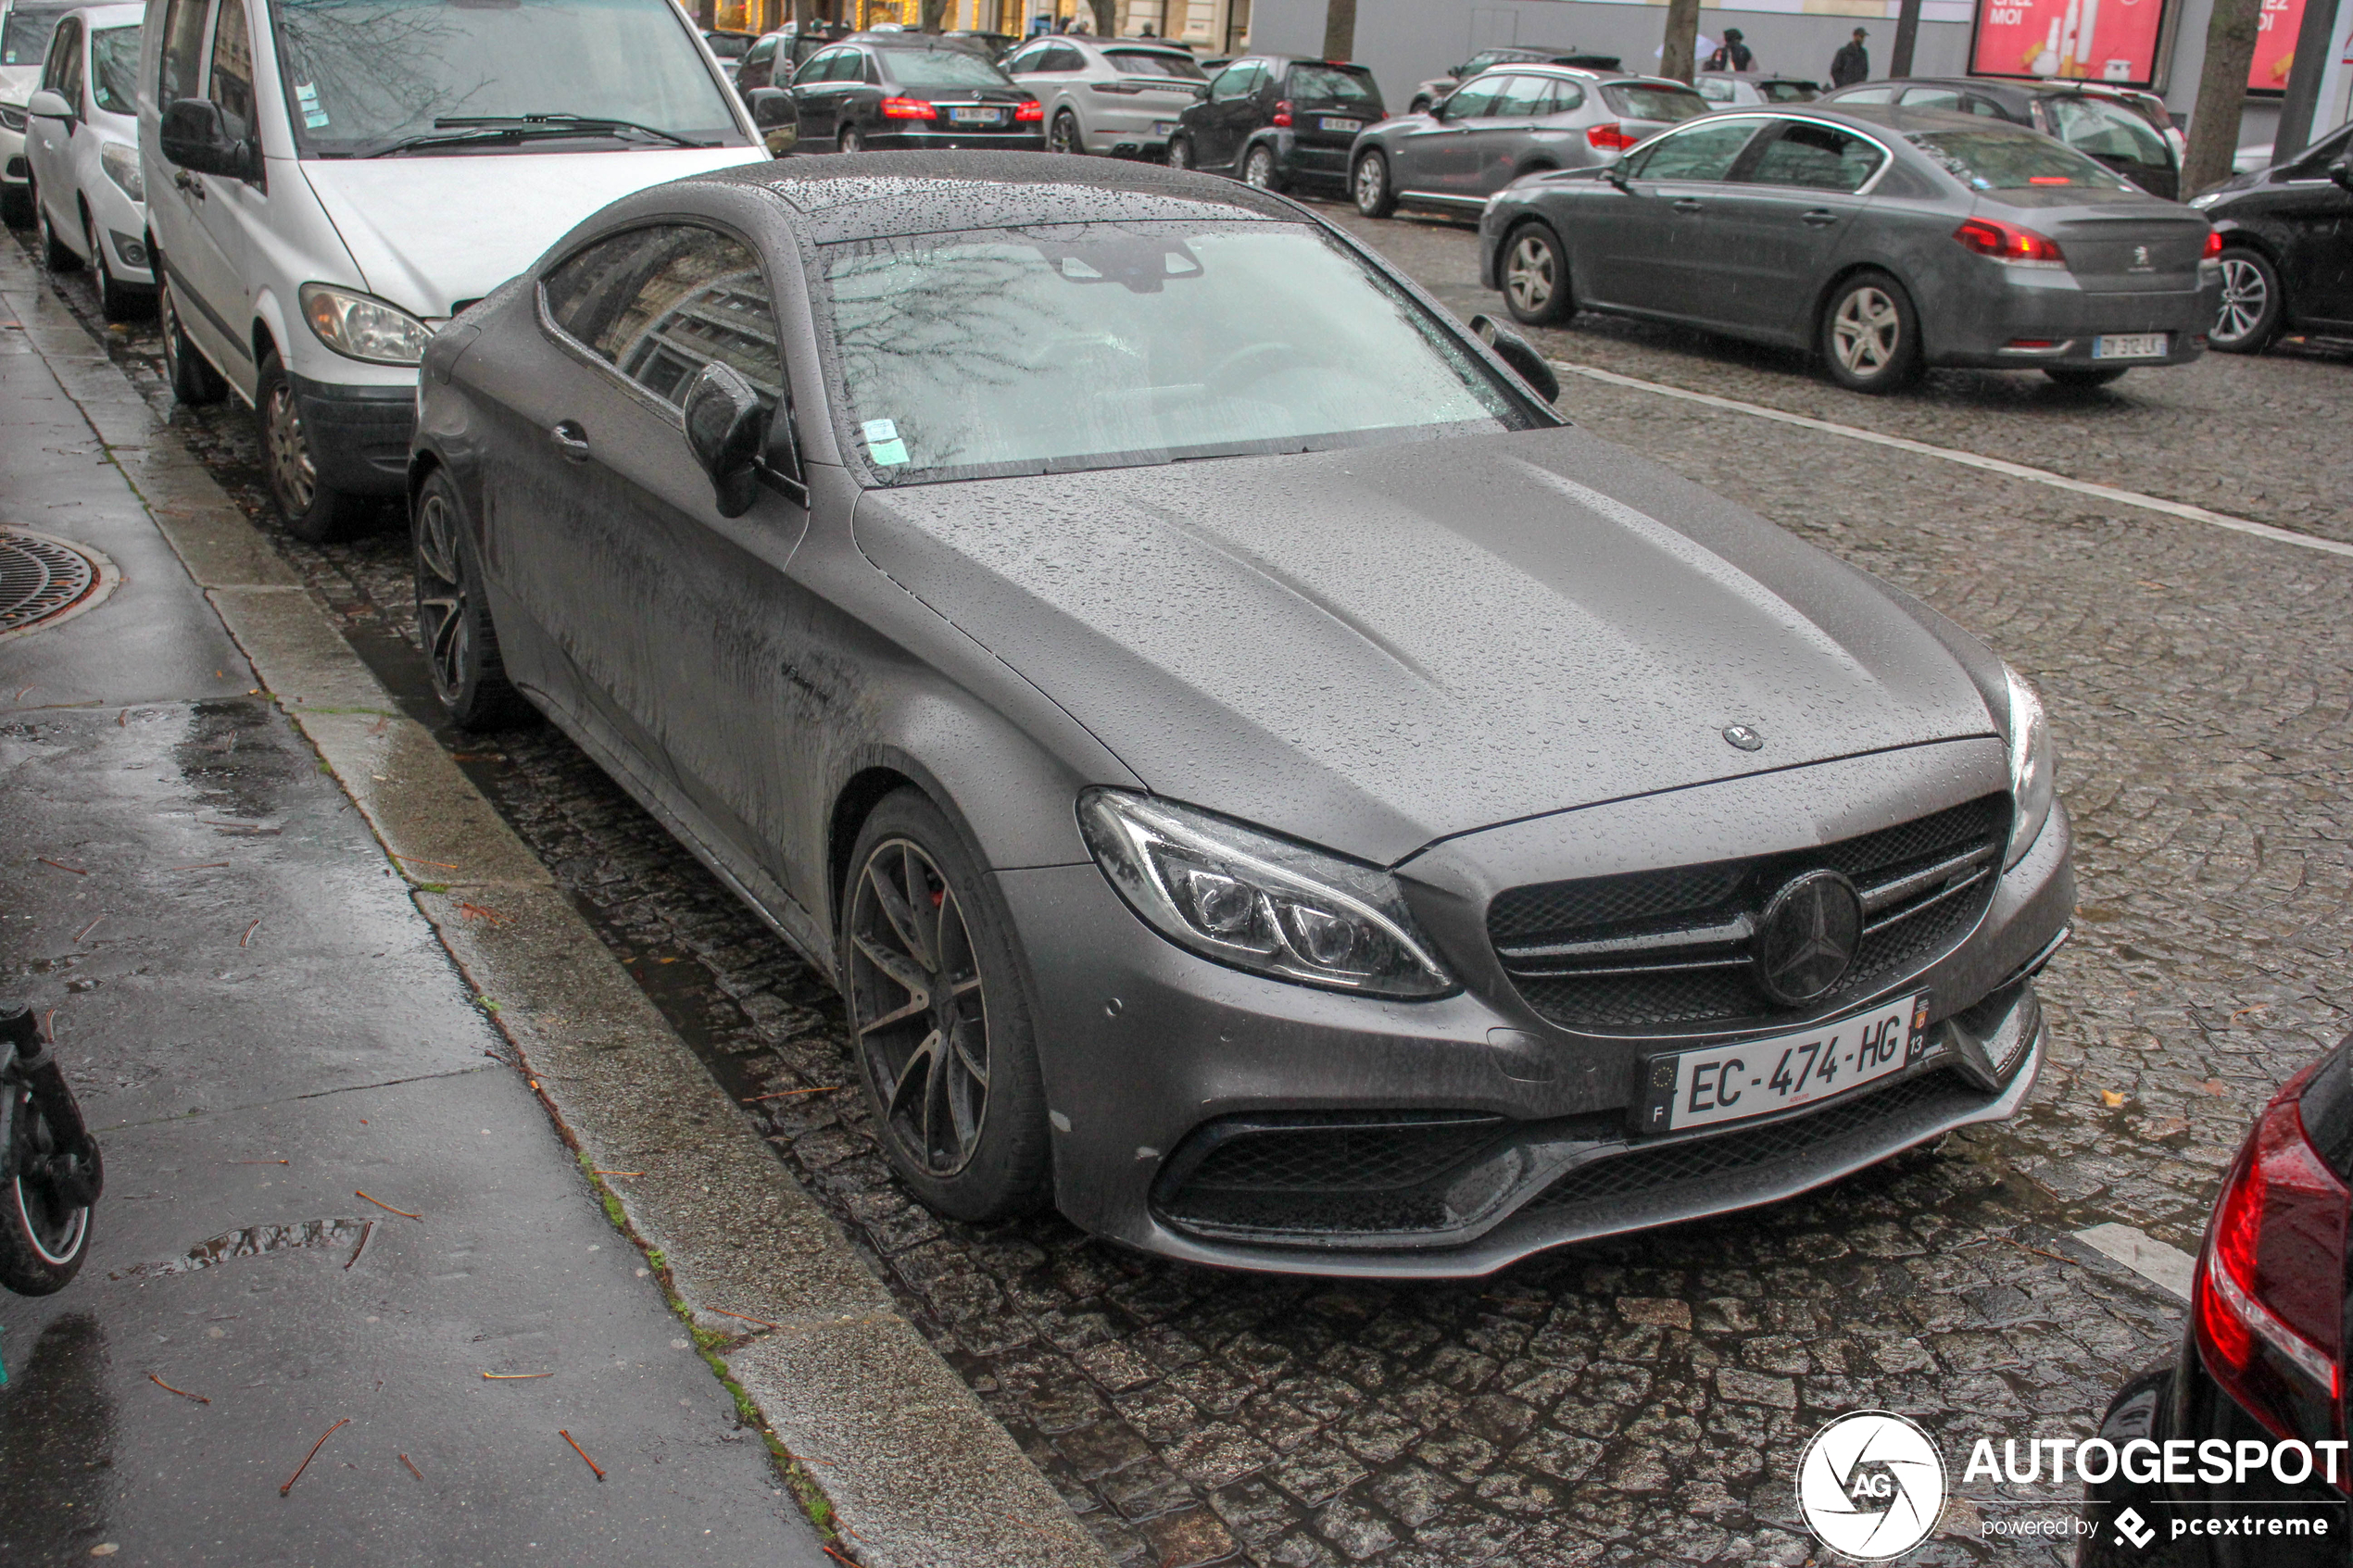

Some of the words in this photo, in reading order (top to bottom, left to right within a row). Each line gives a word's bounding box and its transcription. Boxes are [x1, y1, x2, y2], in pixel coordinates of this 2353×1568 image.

[1989, 7, 2023, 26] MOI
[2257, 12, 2275, 31] OI
[1910, 1035, 1923, 1055] 13
[1688, 1015, 1900, 1113] EC-474-HG
[1653, 1106, 1664, 1123] F
